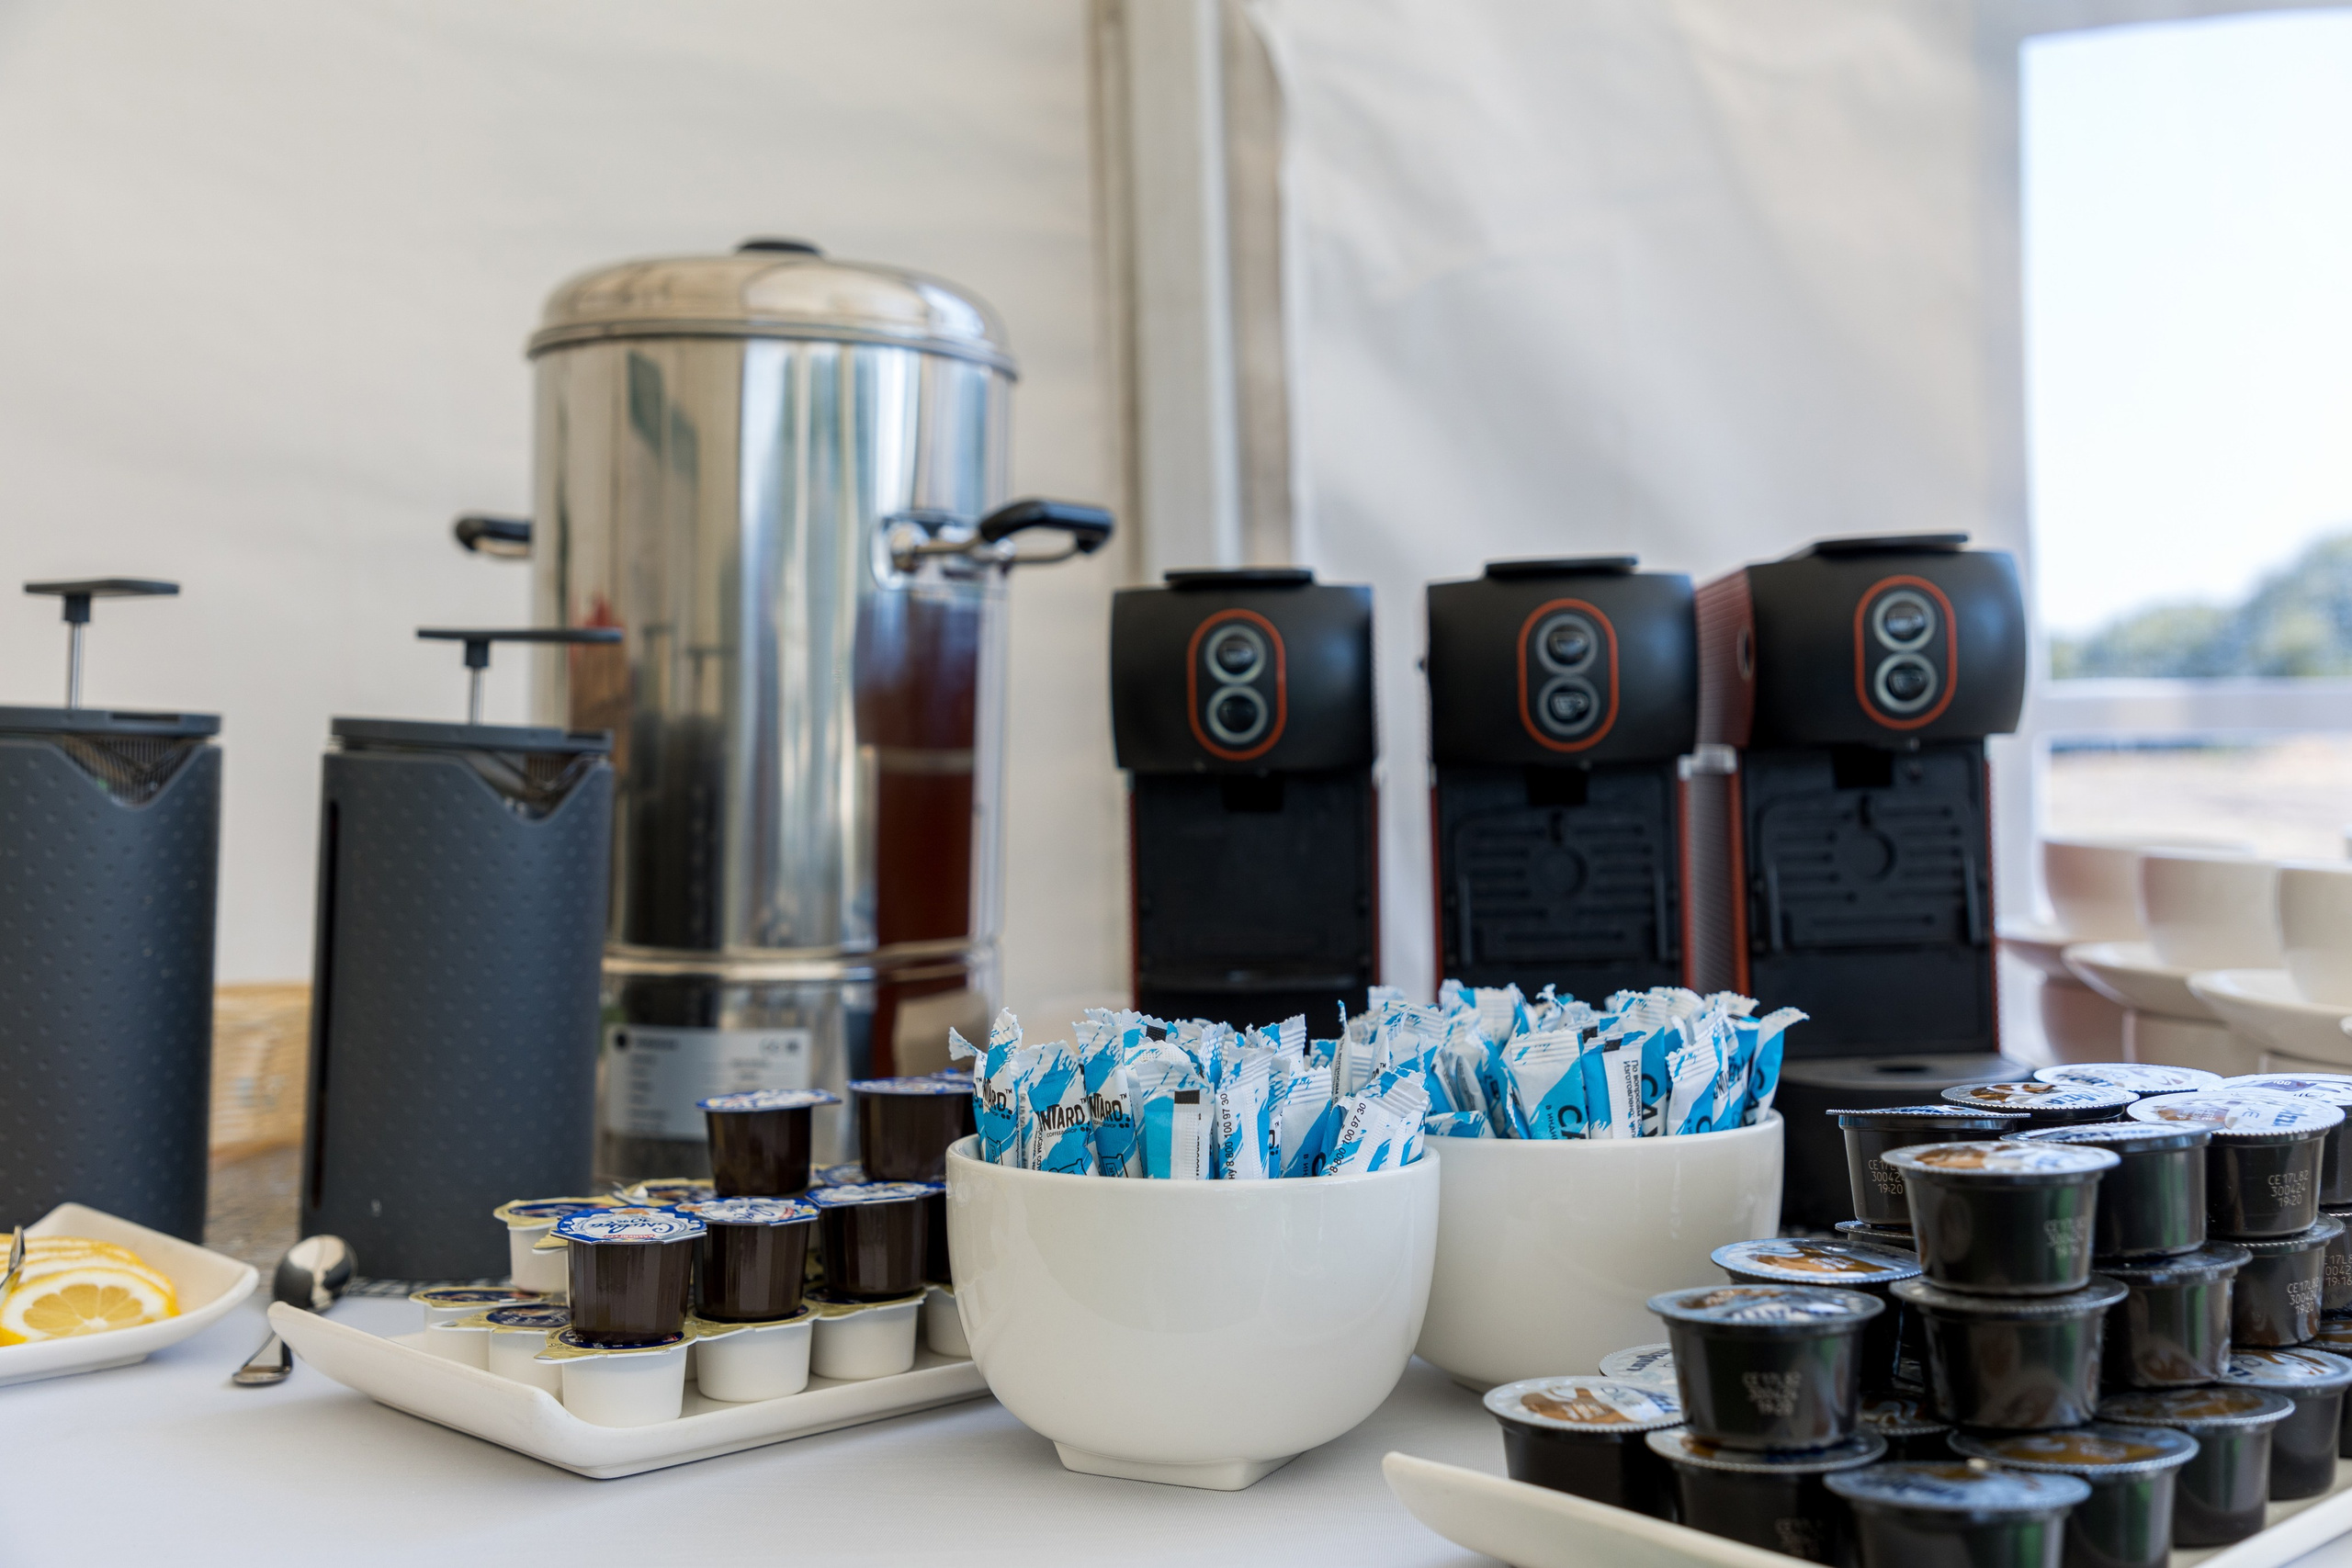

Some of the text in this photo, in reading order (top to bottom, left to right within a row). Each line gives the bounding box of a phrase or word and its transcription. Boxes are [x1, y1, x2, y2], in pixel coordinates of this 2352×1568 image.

[1631, 1059, 1639, 1073] По
[1220, 1093, 1229, 1106] 30
[1633, 1075, 1642, 1117] вопросам
[1222, 1109, 1231, 1120] 97
[1356, 1102, 1366, 1115] 30
[1351, 1115, 1362, 1128] 97
[1224, 1122, 1232, 1138] 100
[1341, 1129, 1355, 1145] 100
[1225, 1141, 1234, 1158] 800
[1333, 1147, 1347, 1165] 800
[1227, 1159, 1235, 1168] 8
[1868, 1159, 1878, 1169] CE
[2267, 1169, 2309, 1186] CE 17L82
[1877, 1183, 1904, 1194] 19:20
[2271, 1182, 2306, 1198] 300424
[2278, 1194, 2302, 1208] 19:20
[2331, 1255, 2352, 1265] 17L8
[2325, 1266, 2352, 1276] 0042
[2287, 1282, 2299, 1294] CE
[2295, 1302, 2314, 1314] 19:20
